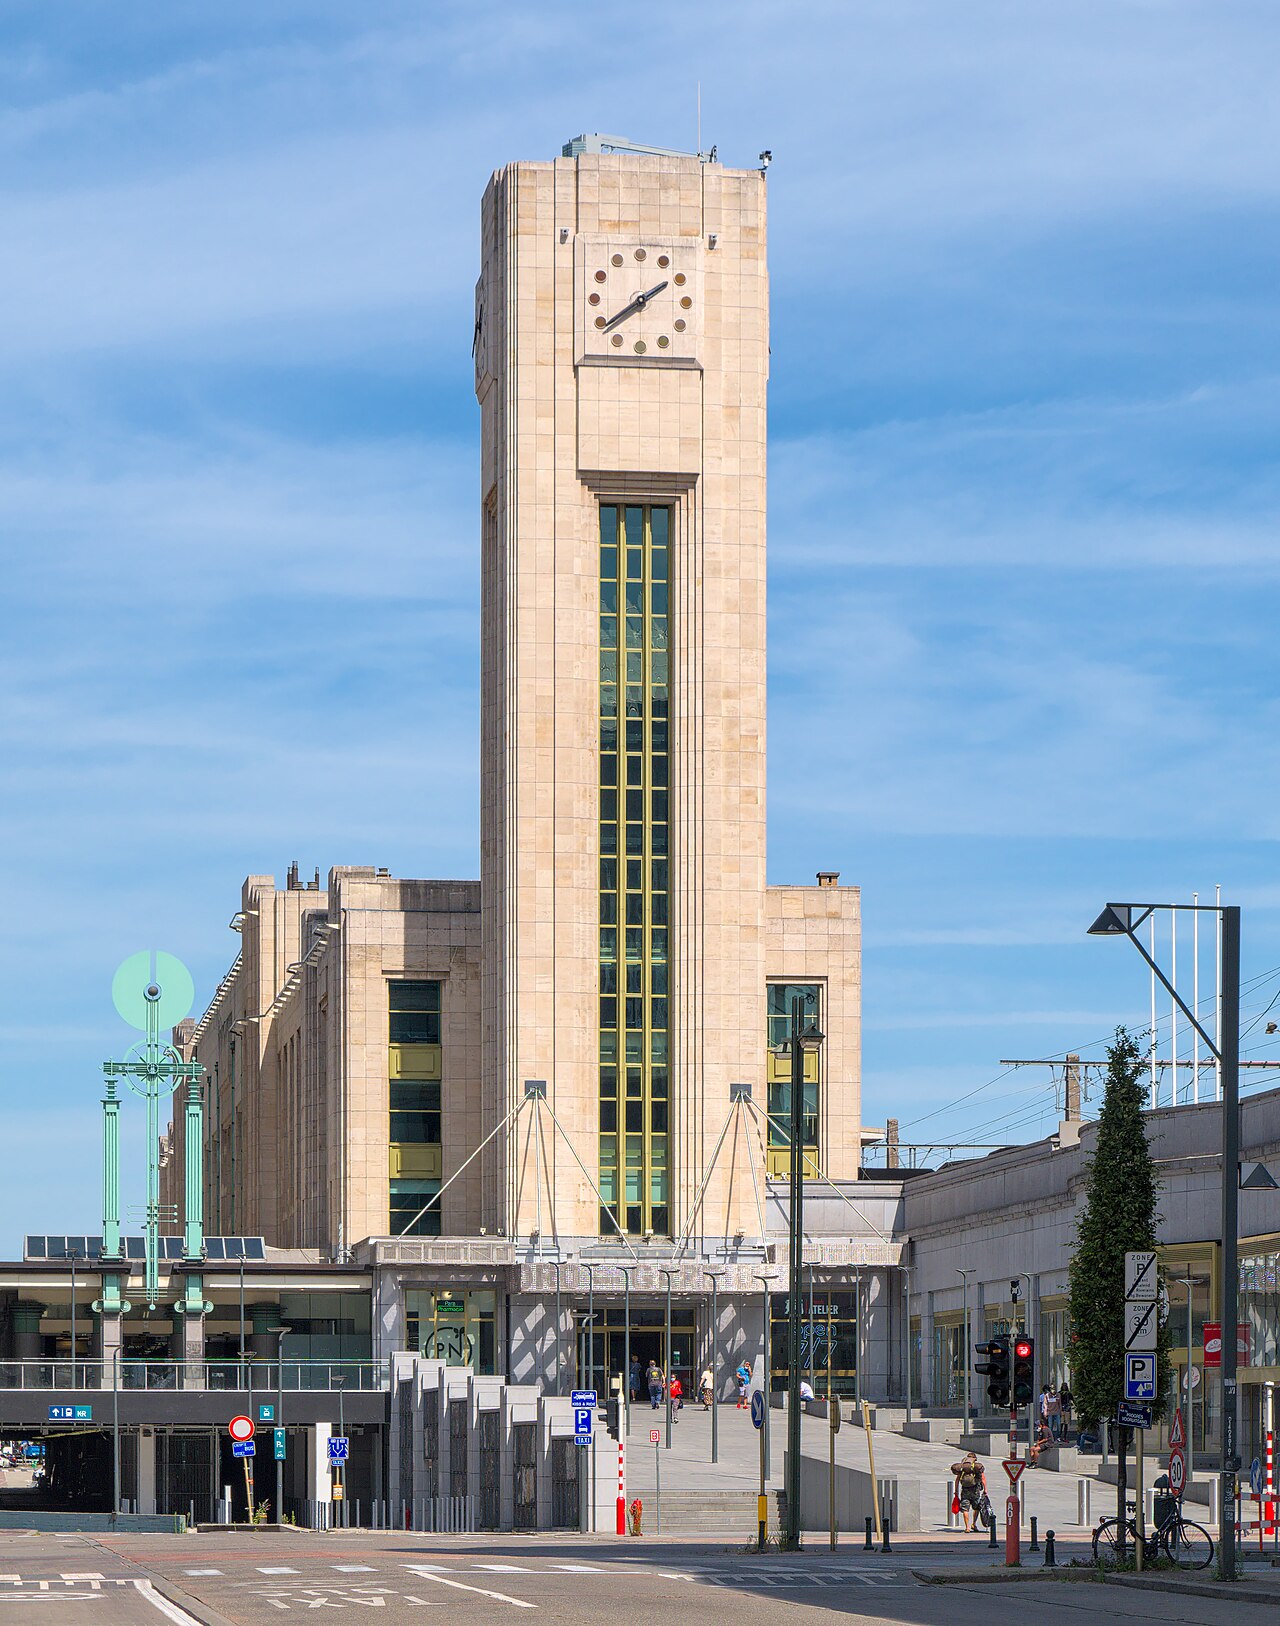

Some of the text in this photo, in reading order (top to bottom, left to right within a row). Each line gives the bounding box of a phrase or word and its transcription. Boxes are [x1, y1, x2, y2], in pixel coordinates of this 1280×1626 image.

[1136, 1263, 1146, 1275] P
[437, 1340, 463, 1359] PN
[1131, 1360, 1146, 1380] P
[578, 1411, 588, 1424] P
[1172, 1461, 1182, 1483] 30
